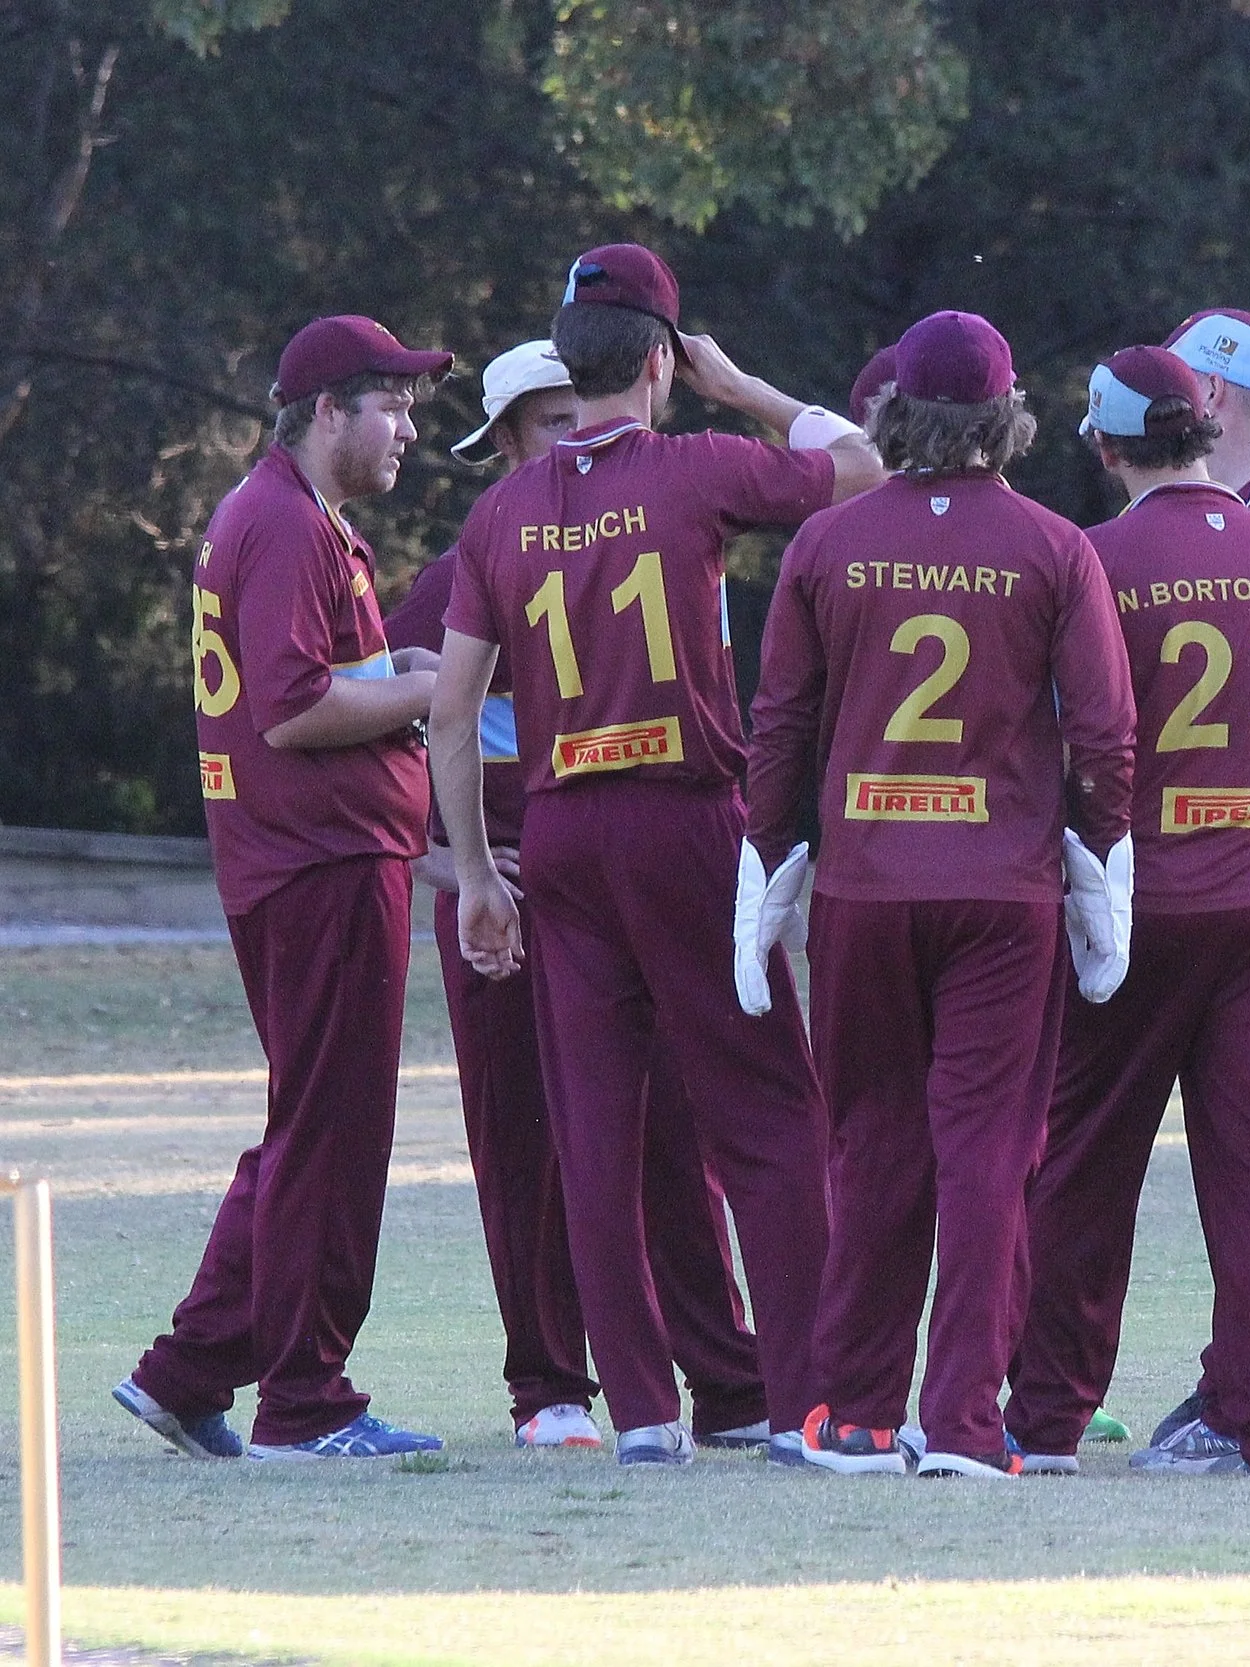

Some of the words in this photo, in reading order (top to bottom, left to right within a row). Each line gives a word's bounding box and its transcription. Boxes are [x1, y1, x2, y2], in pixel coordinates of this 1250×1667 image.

[520, 505, 647, 552] FRENCH
[846, 560, 1021, 597] STEWART
[524, 552, 677, 698] 11
[193, 583, 240, 717] 5
[883, 613, 971, 744] 2
[559, 726, 669, 768] PIRELLI
[856, 782, 976, 813] PIRELLI
